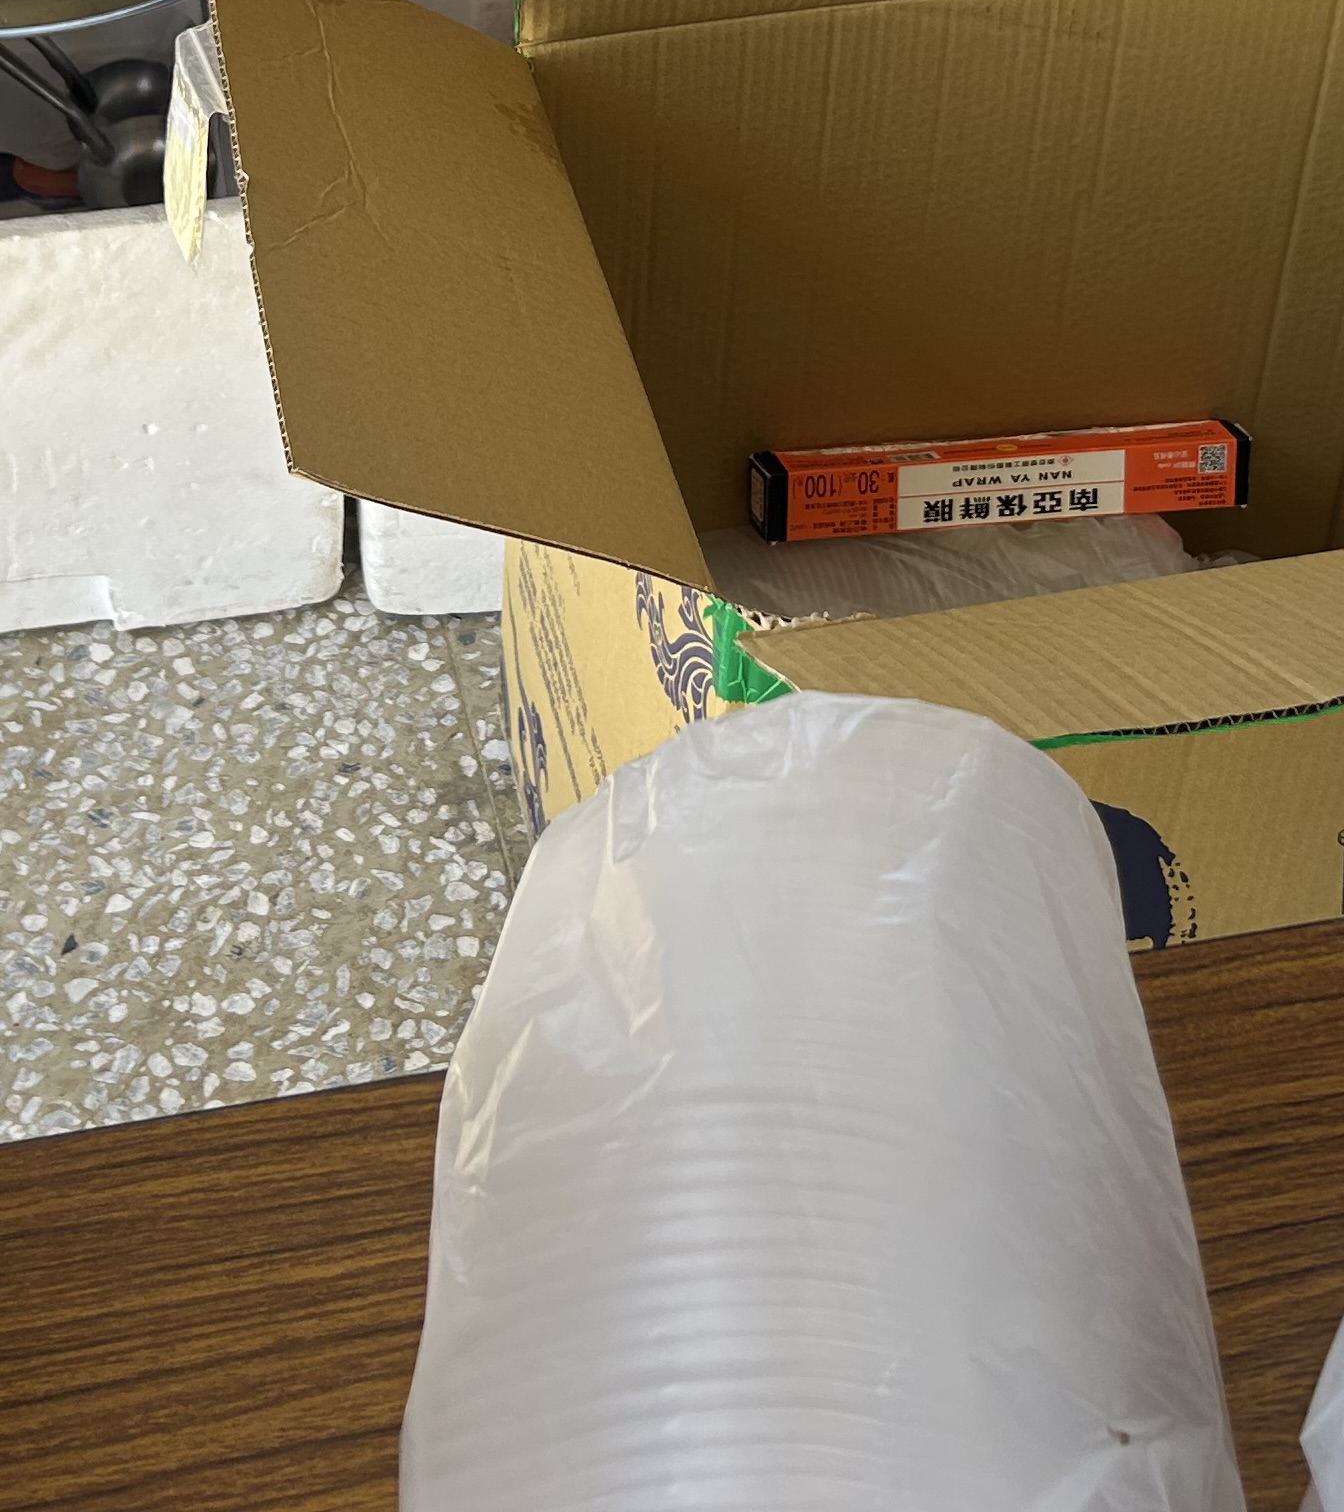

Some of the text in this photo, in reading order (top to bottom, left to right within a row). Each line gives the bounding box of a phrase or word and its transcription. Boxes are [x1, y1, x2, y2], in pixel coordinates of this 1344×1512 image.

[951, 470, 1073, 487] NAN YA WRAP
[922, 487, 1099, 524] 南亞保鮮膜
